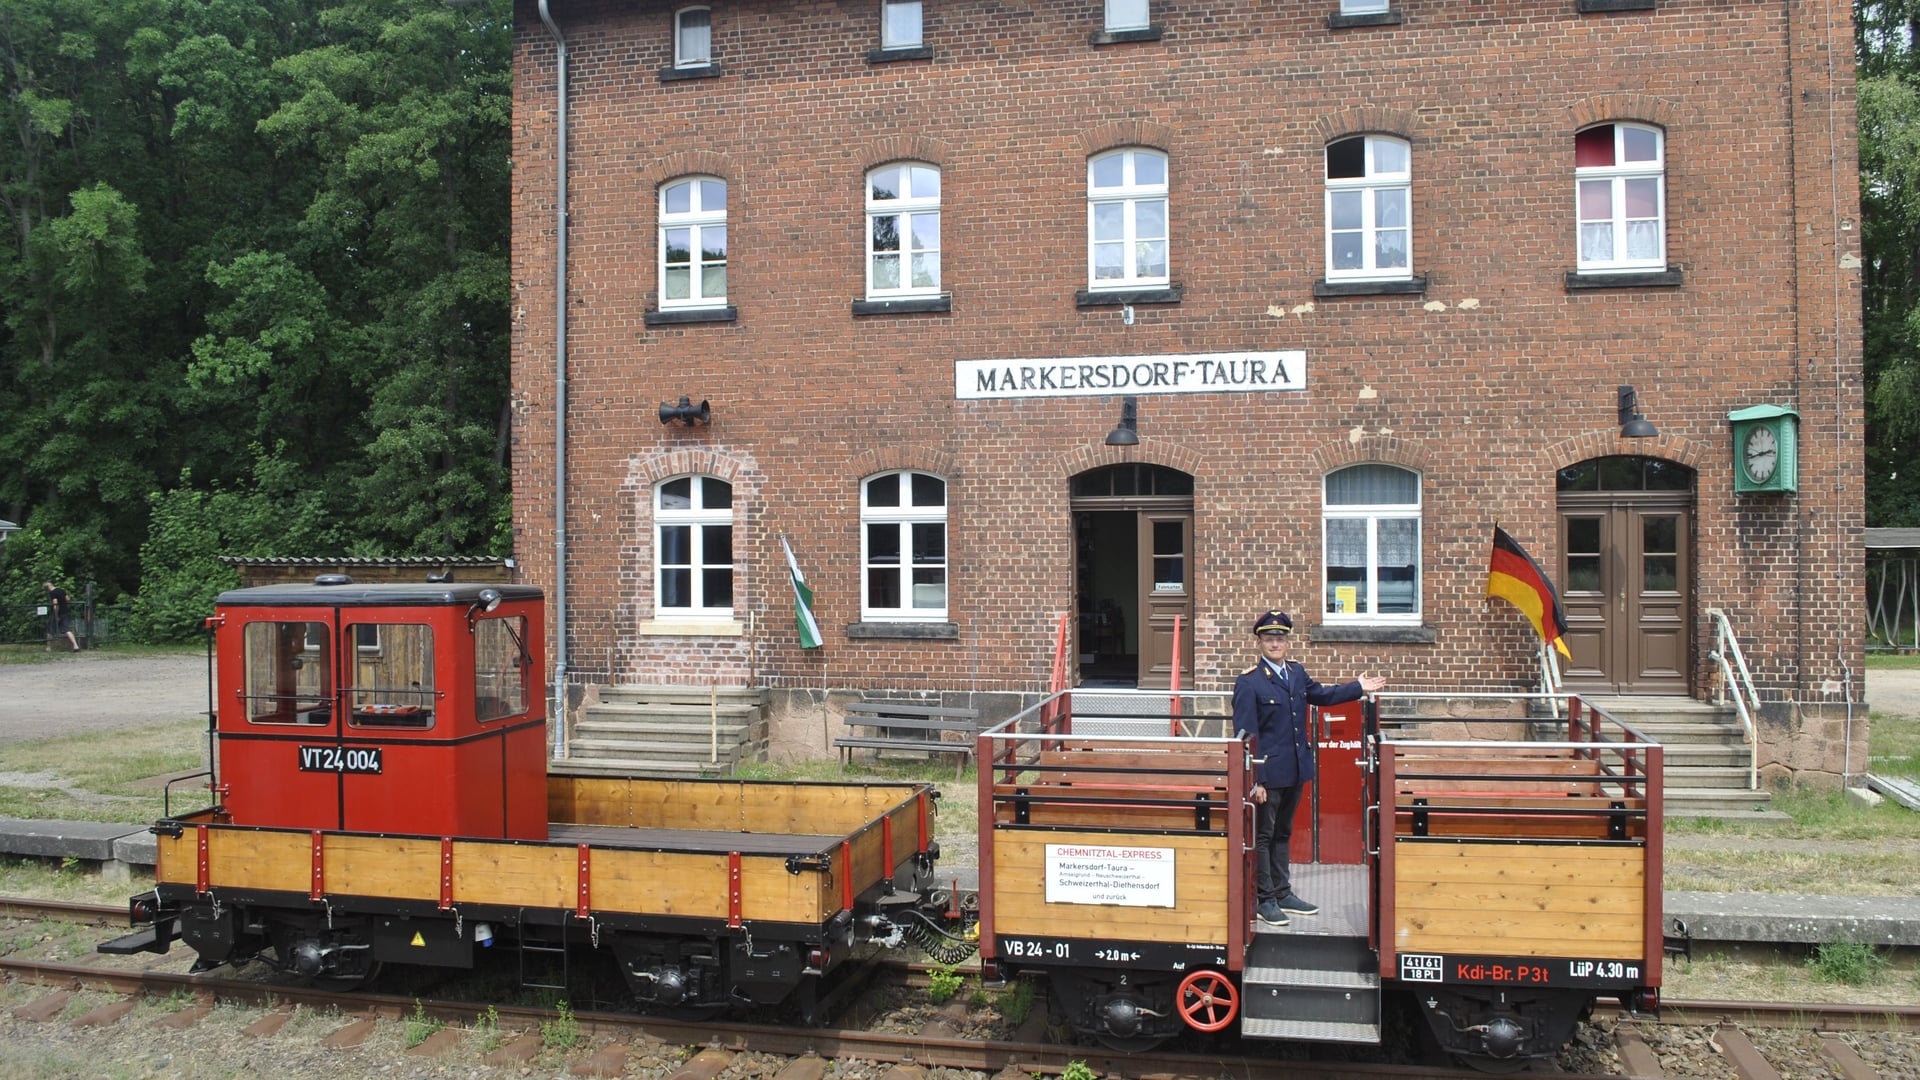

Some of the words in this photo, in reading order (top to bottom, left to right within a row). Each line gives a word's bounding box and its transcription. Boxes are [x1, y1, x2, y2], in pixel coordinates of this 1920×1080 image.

[1057, 847, 1162, 860] CHEMNITZTAL-EXPRESS
[1004, 940, 1024, 956] VB
[1026, 942, 1042, 957] 24
[1055, 943, 1070, 958] 01
[1106, 949, 1119, 961] 2.0
[1120, 952, 1129, 962] m
[1216, 956, 1226, 965] Zu
[1426, 958, 1433, 968] 6
[1411, 969, 1422, 979] 18
[1569, 961, 1594, 977] LüP
[1596, 962, 1623, 978] 4.30
[1626, 966, 1639, 979] m
[1120, 975, 1127, 985] 2
[1500, 992, 1505, 1003] 1
